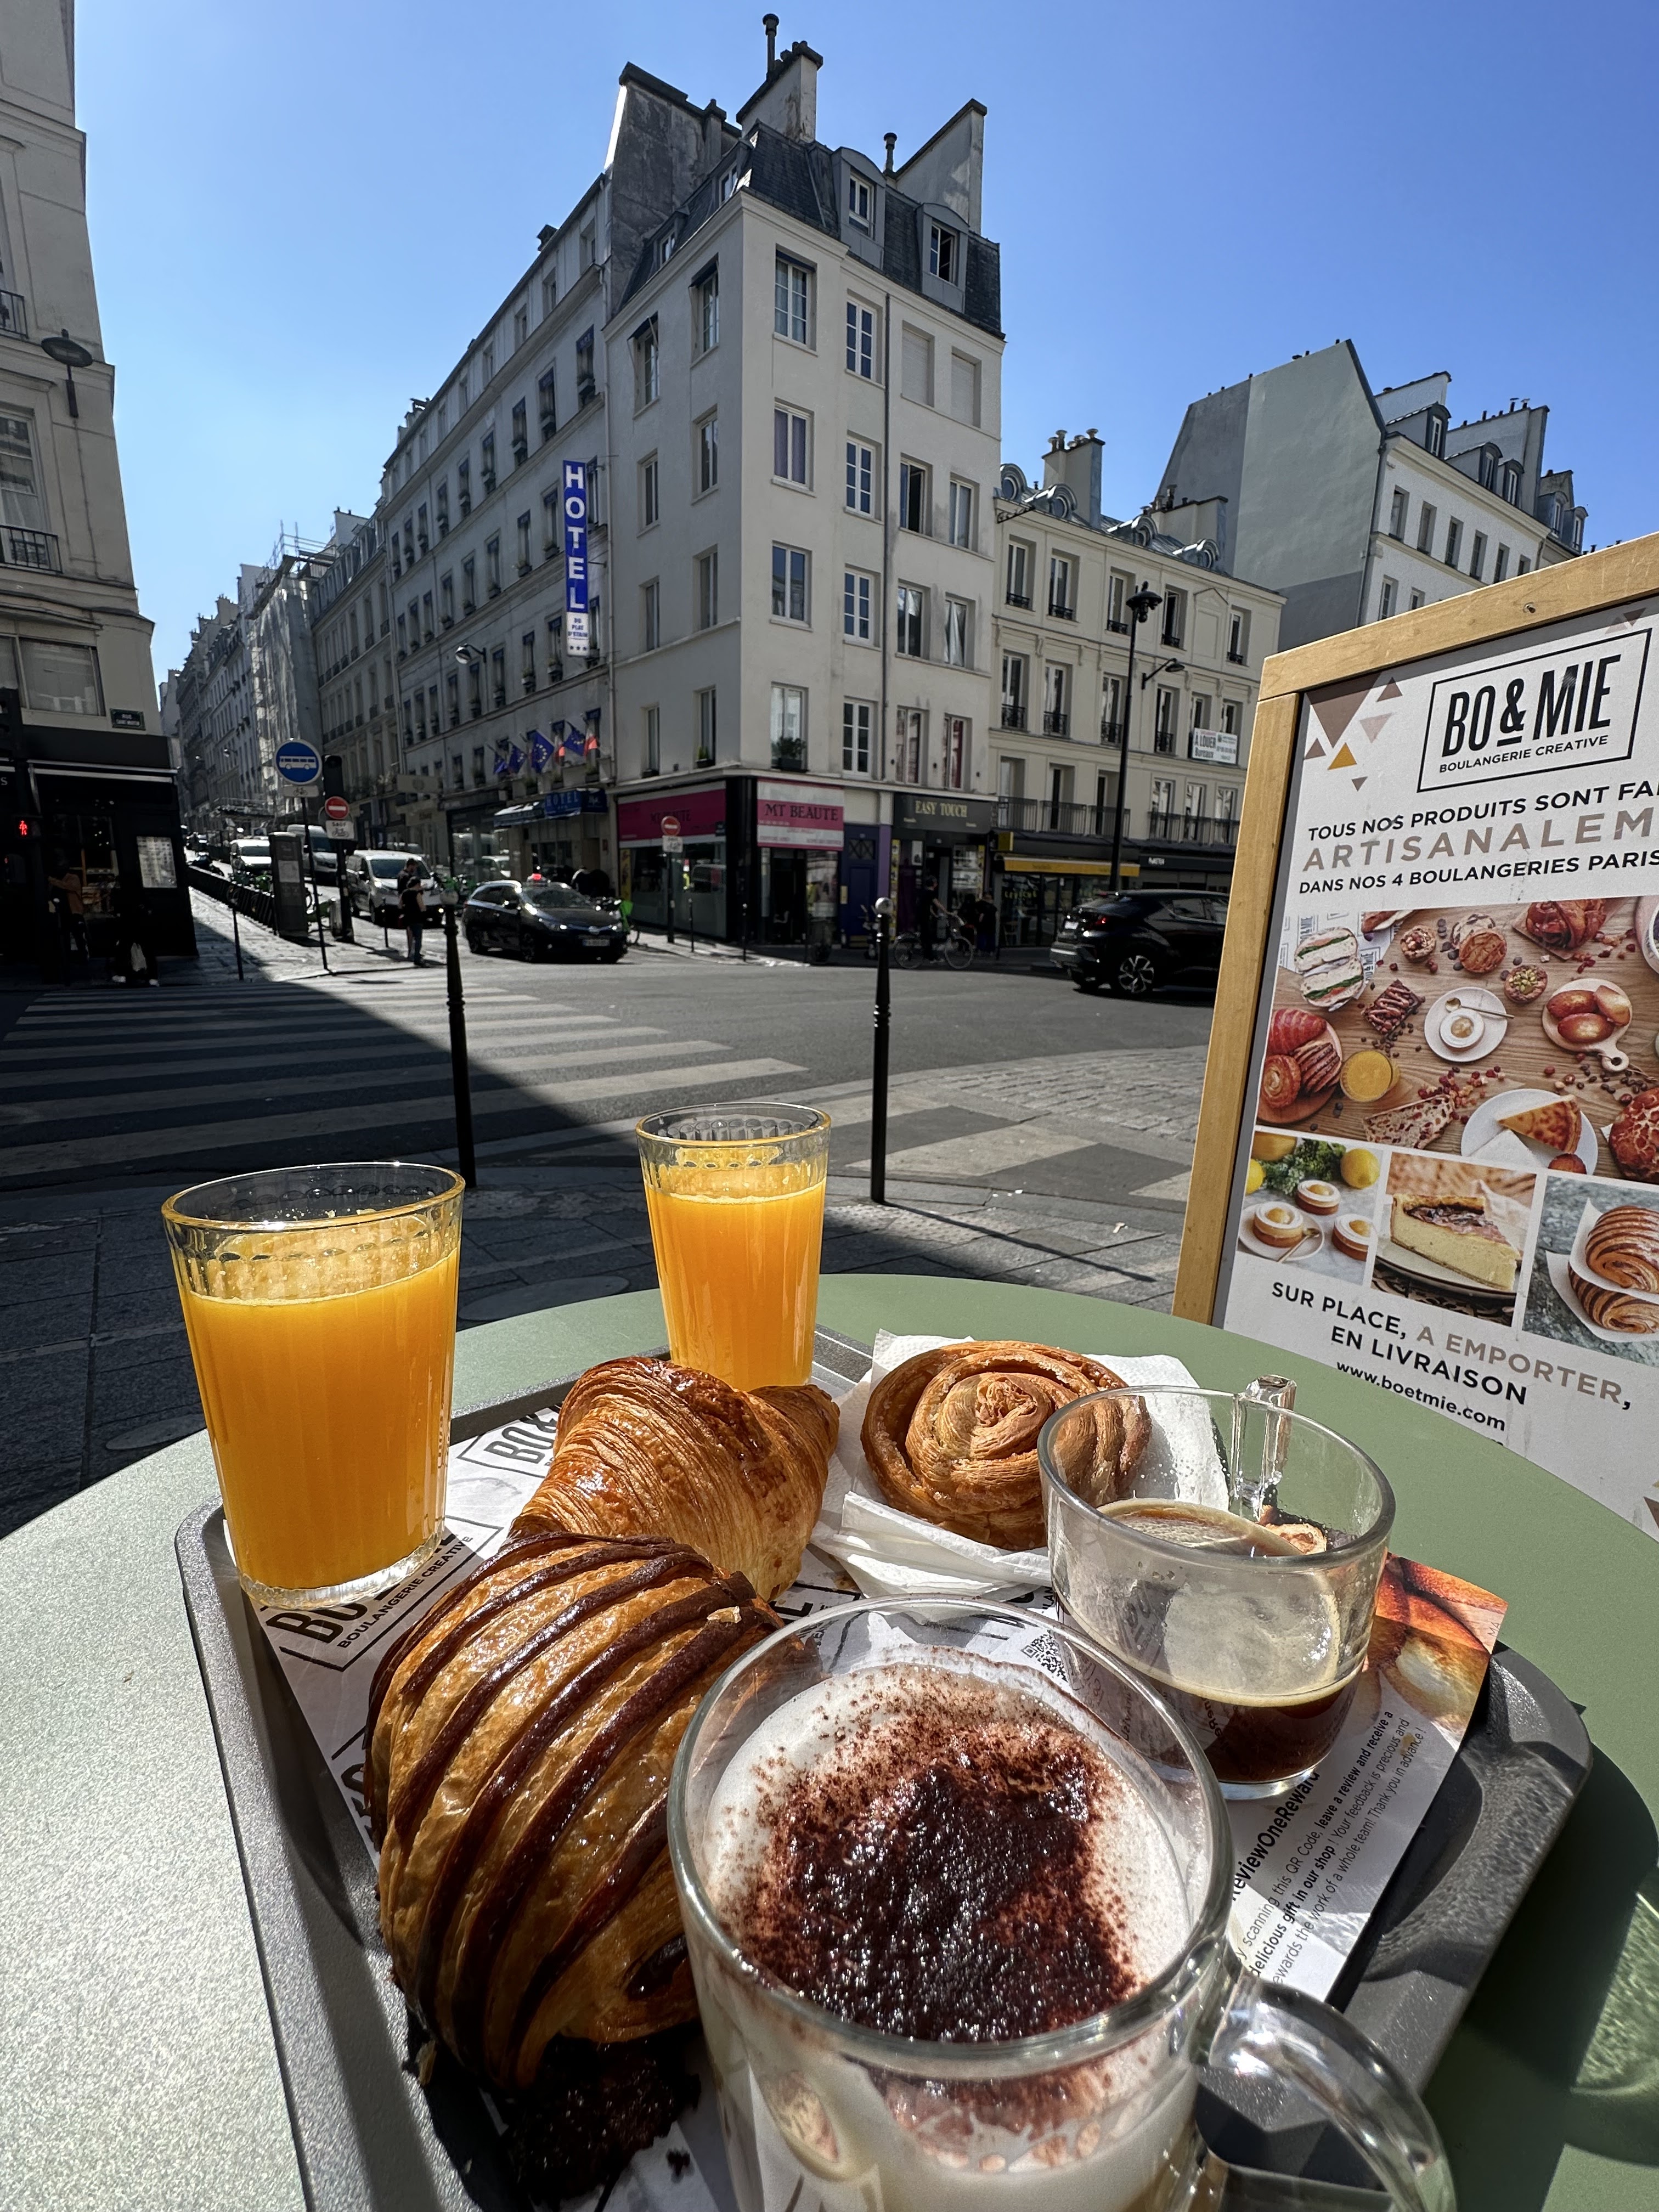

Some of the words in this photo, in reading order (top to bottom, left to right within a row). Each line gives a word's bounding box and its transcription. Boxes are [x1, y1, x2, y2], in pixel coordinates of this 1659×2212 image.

[565, 465, 585, 609] HOTEL
[1200, 735, 1216, 748] LOUER
[1440, 749, 1531, 773] BOULANGERIE
[1536, 735, 1609, 756] CREATIVE
[546, 791, 578, 806] HOTEL
[765, 803, 786, 816] MT
[790, 805, 838, 821] BEAUTE
[915, 800, 936, 815] EASY
[940, 803, 967, 817] TOUCH
[1308, 822, 1356, 840] TOUS
[1362, 815, 1404, 834] NOS
[1410, 798, 1526, 827] PRODUITS
[1534, 786, 1610, 811] SONT
[1618, 780, 1659, 800] FA
[1303, 806, 1654, 872] ARTISANALEM
[1299, 879, 1344, 894] DANS
[1349, 874, 1386, 890] NOS
[1392, 873, 1403, 886] 4
[1409, 857, 1579, 885] BOULANGERIES
[1272, 1282, 1314, 1308] SUR
[1322, 1296, 1406, 1340] PLACE,
[1416, 1325, 1434, 1346] A
[1446, 1333, 1631, 1410] EMPORTER,
[1331, 1325, 1363, 1350] EN
[1372, 1339, 1527, 1405] LIVRAISON
[1336, 1362, 1505, 1431] www.boetmie.com
[338, 1578, 424, 1648] BOULANGERIE
[422, 1536, 473, 1577] CREATIVE
[1400, 1732, 1424, 1768] advance
[1385, 1776, 1401, 1795] you
[1393, 1767, 1407, 1778] in
[1367, 1793, 1392, 1819] Thank
[1243, 1896, 1280, 1947] scanning
[1272, 1875, 1292, 1895] this
[1285, 1857, 1304, 1874] QR
[1297, 1831, 1324, 1856] Code,
[1314, 1804, 1338, 1829] leave
[1338, 1767, 1361, 1797] review
[1357, 1748, 1372, 1767] and
[1366, 1719, 1389, 1750] receive
[1352, 1817, 1376, 1844] team!
[1249, 1923, 1287, 1978] delicious
[1282, 1901, 1300, 1925] gift
[1293, 1890, 1308, 1902] in
[1304, 1869, 1319, 1889] our
[1314, 1845, 1336, 1870] shop
[1330, 1818, 1352, 1838] Your
[1345, 1779, 1376, 1819] feedback
[1368, 1771, 1381, 1781] is
[1375, 1735, 1401, 1773] precious
[1395, 1718, 1410, 1736] and
[1336, 1843, 1361, 1873] whole
[1325, 1878, 1338, 1894] of
[1333, 1873, 1344, 1882] a
[1310, 1893, 1331, 1921] work
[1295, 1920, 1314, 1941] the
